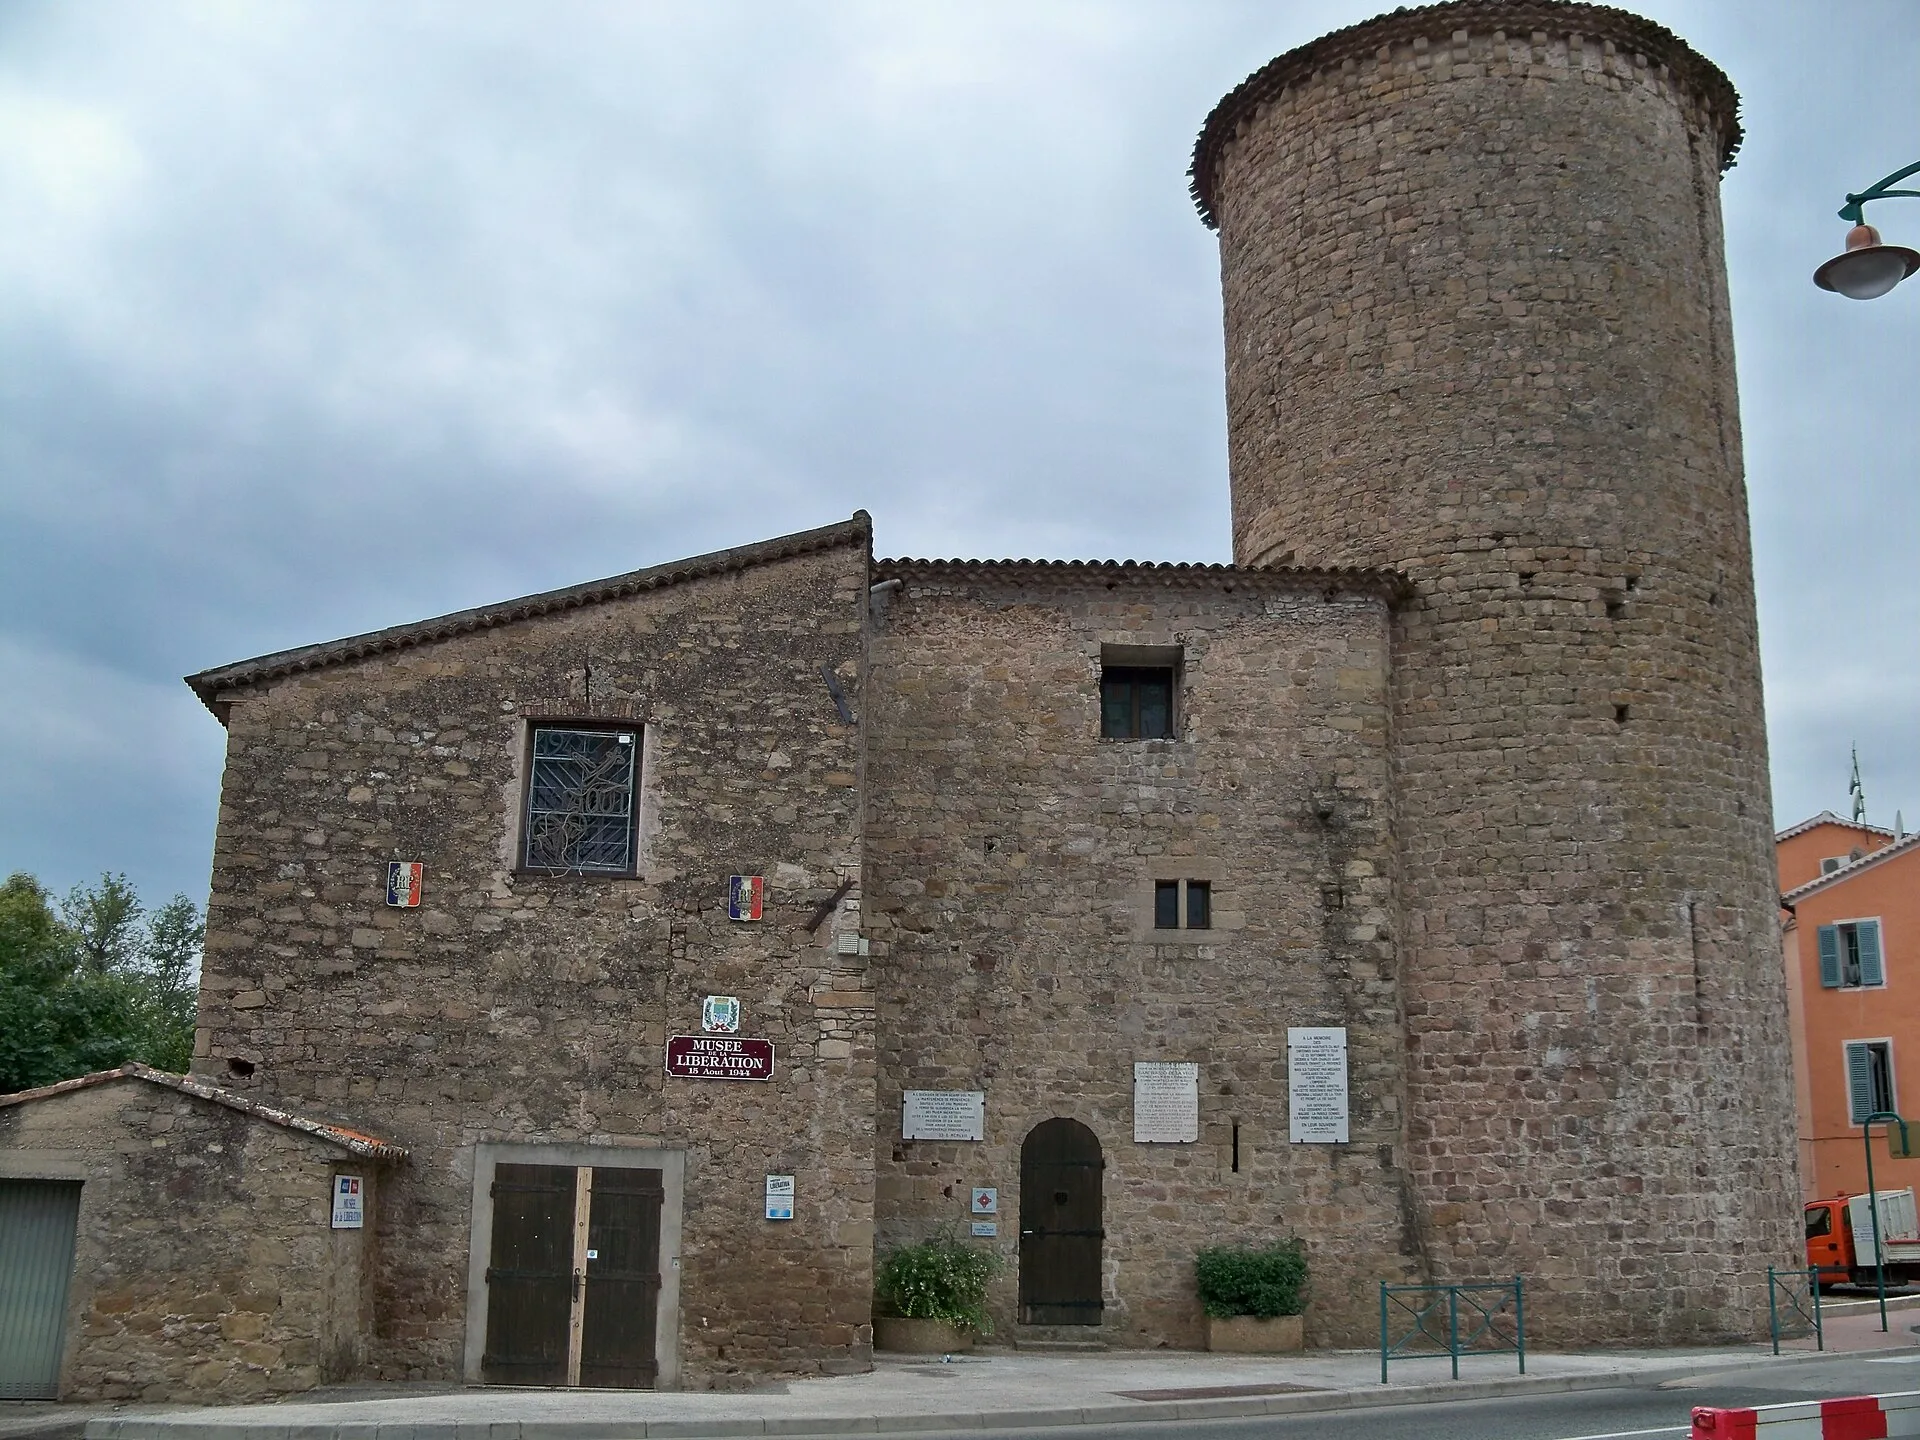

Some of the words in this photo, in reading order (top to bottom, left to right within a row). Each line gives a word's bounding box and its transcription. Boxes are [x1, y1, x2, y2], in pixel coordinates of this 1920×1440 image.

[395, 875, 414, 889] RF
[737, 889, 755, 903] RF
[692, 1039, 743, 1052] MUSEE
[676, 1055, 764, 1069] LIBERATION
